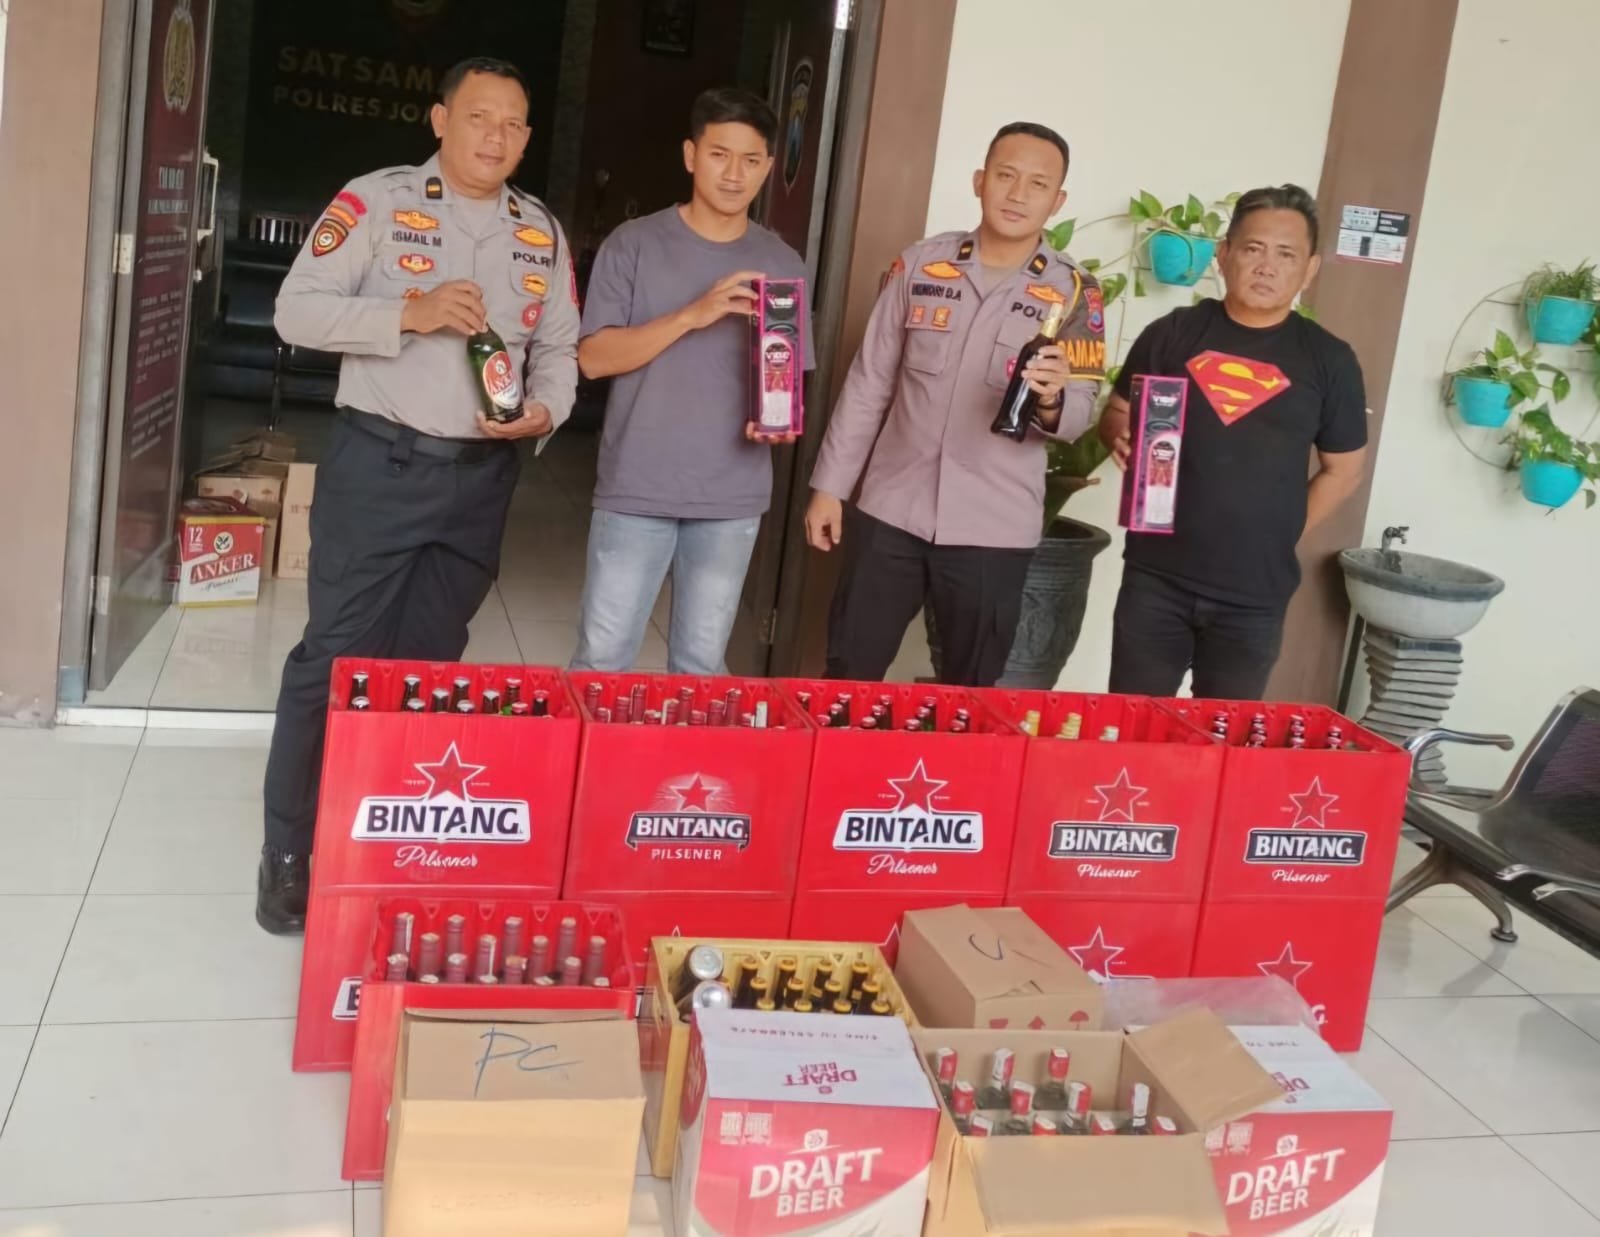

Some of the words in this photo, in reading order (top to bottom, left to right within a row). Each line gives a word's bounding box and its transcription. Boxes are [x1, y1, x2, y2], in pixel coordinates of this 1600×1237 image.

[276, 45, 348, 80] SAT
[353, 55, 437, 94] SAM
[272, 84, 382, 117] POLRES
[391, 230, 430, 246] ISMAIL
[432, 236, 442, 248] M
[188, 526, 204, 544] 12
[192, 553, 255, 583] ANKER
[366, 805, 519, 835] BINTANG
[636, 817, 744, 838] BINTANG
[845, 816, 972, 844] BINTANG
[651, 848, 722, 860] PILSENER
[1058, 828, 1165, 853] BINTANG
[1254, 835, 1353, 858] BINTANG
[474, 1023, 584, 1099] PC
[798, 1061, 838, 1074] BEER
[782, 1069, 858, 1086] DRAFT
[749, 1147, 884, 1199] DRAFT
[1225, 1148, 1347, 1206] DRAFT
[776, 1186, 844, 1218] BEER
[1249, 1188, 1310, 1221] BEER
